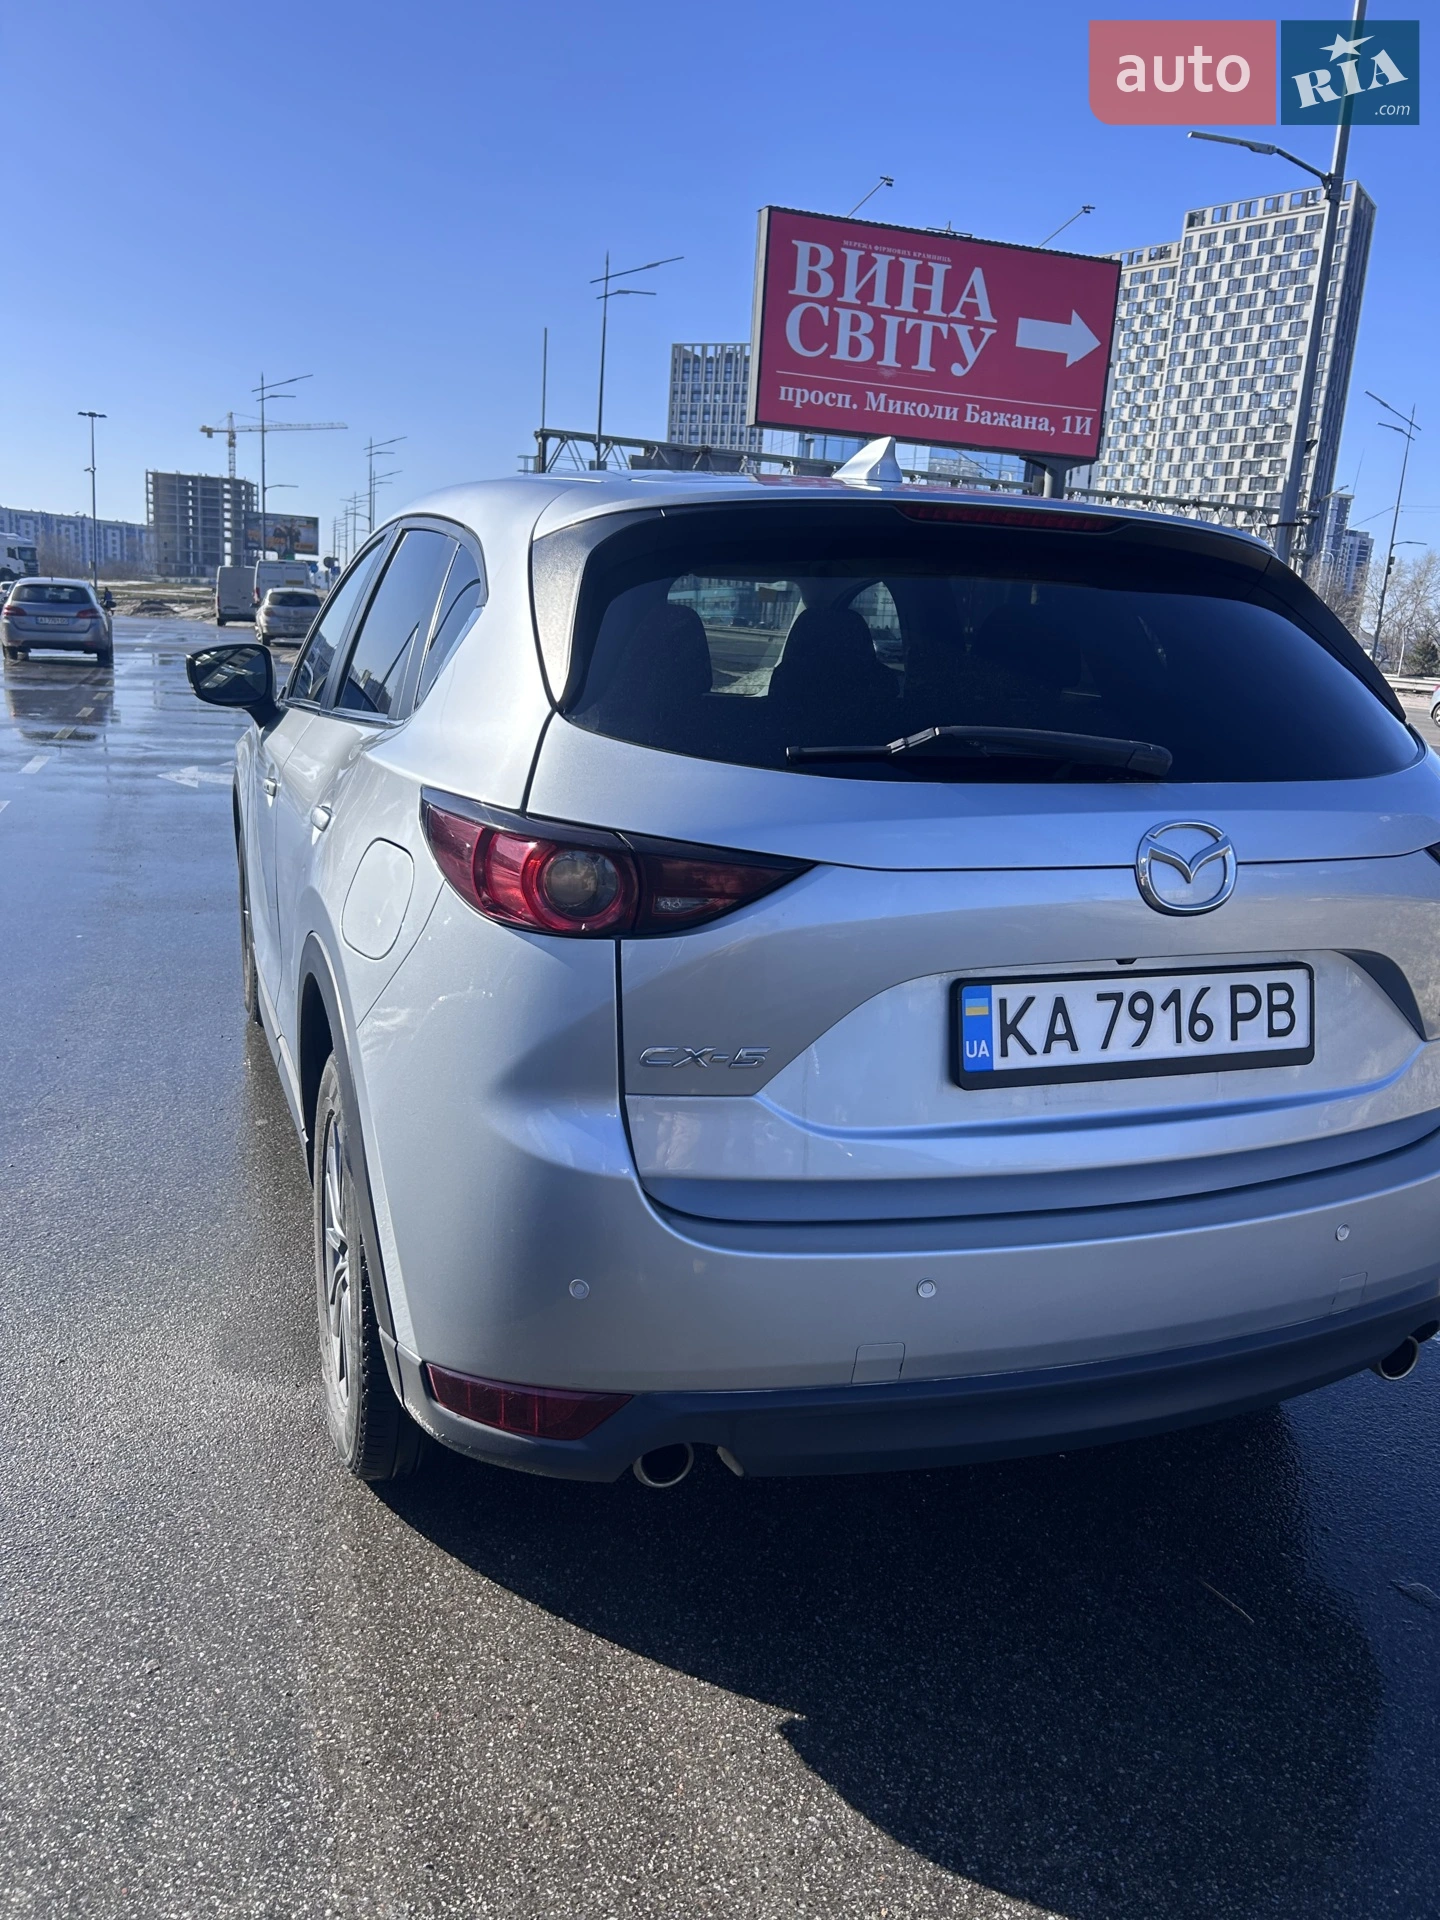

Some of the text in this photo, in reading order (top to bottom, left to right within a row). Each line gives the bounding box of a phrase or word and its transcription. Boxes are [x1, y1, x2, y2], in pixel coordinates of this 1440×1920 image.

[843, 240, 872, 250] МЕРЕЖА
[788, 239, 997, 324] ВИНА
[785, 301, 997, 378] СВІТУ
[779, 385, 858, 410] просп.
[864, 391, 959, 422] Миколи
[965, 403, 1056, 436] Бажана,
[998, 981, 1296, 1058] KA 7916 PB
[639, 1045, 771, 1069] CX-5
[965, 1039, 990, 1059] UA
